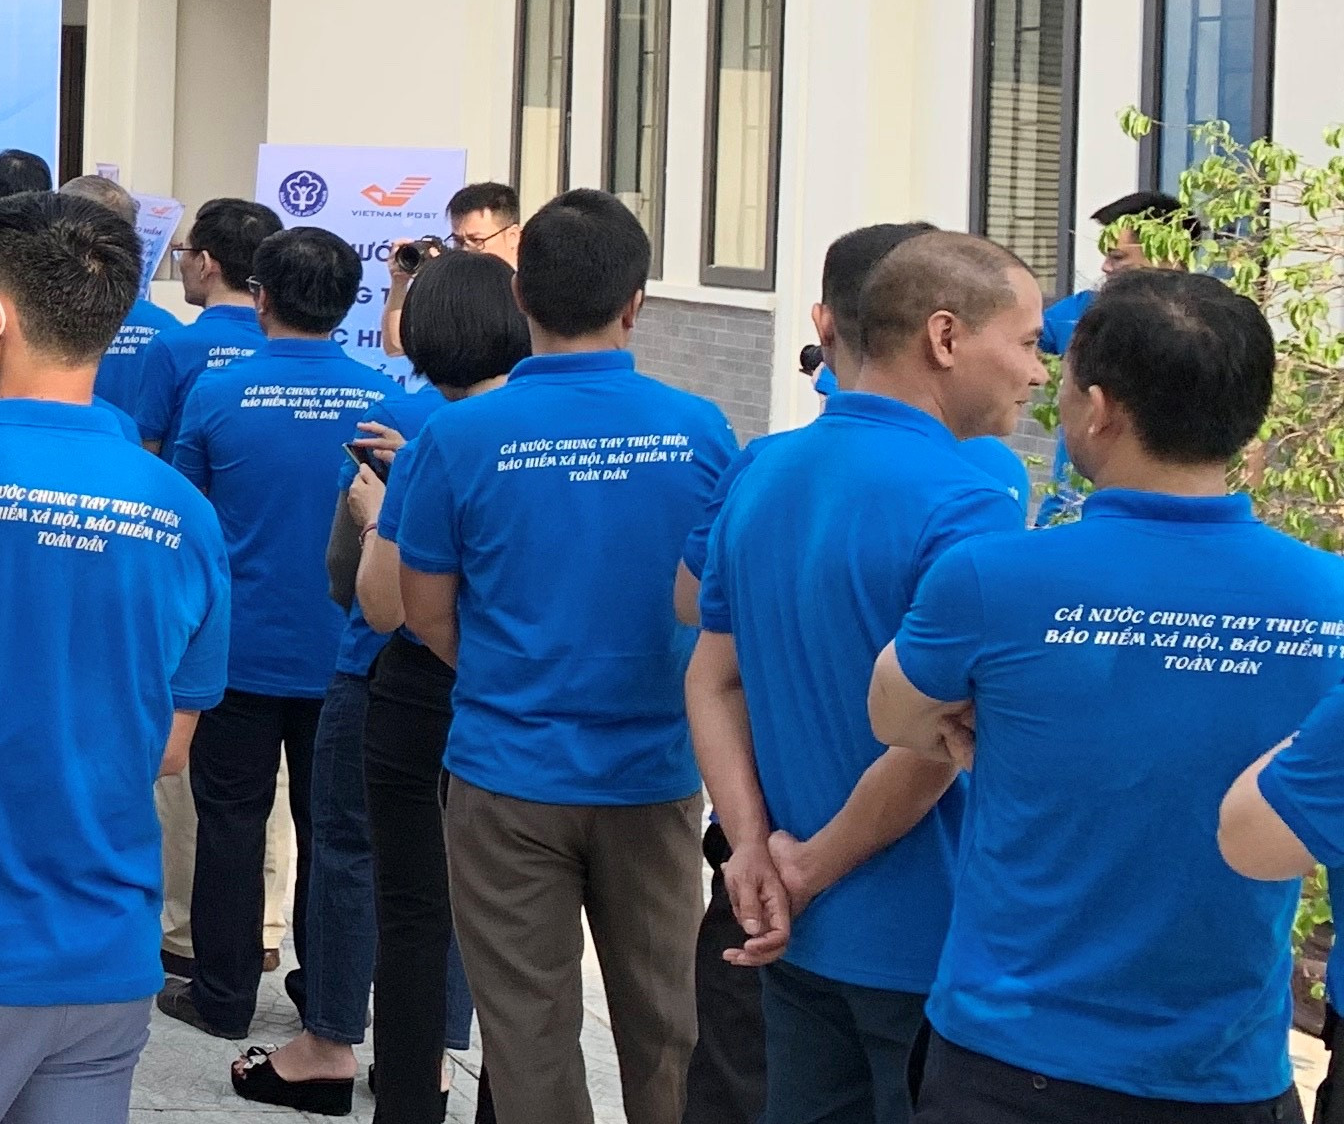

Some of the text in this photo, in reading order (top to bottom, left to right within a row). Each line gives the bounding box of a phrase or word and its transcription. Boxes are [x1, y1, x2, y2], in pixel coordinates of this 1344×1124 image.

[351, 210, 439, 220] VIETNAM POST
[28, 488, 76, 507] CHUNG
[79, 494, 110, 510] TAY
[112, 496, 152, 518] THỰC
[1055, 604, 1084, 622] CẢ
[1149, 611, 1215, 628] CHUNG
[1222, 614, 1260, 631] TAY
[1266, 618, 1317, 636] THỰC
[1044, 626, 1089, 644] BẢO
[1094, 627, 1146, 646] HIỂM
[1230, 636, 1271, 653] BẢO
[1276, 638, 1323, 659] HIỂM
[1164, 651, 1262, 675] TOÀN DÂN
